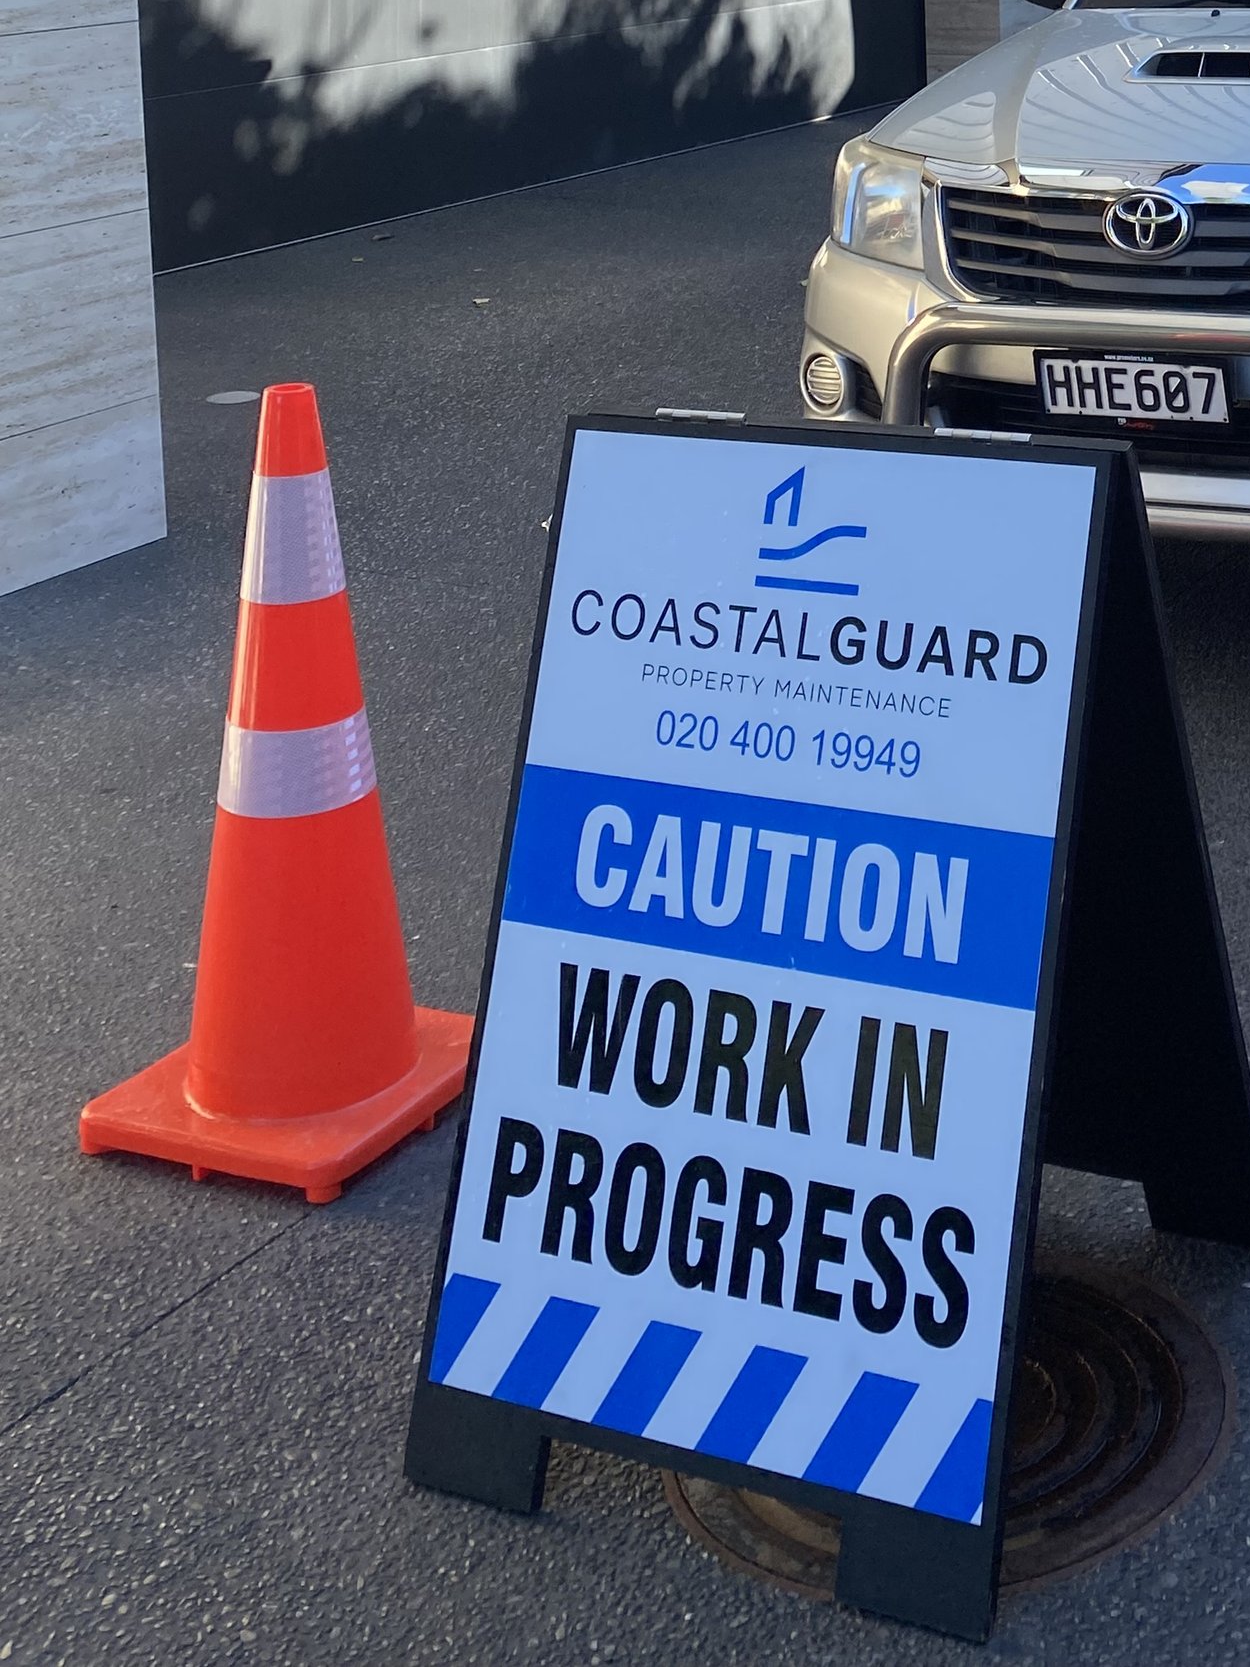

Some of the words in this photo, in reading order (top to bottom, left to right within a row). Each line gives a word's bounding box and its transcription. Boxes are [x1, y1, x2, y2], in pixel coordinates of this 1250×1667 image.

[1045, 364, 1217, 415] HHE607
[571, 589, 1048, 685] COASTALGUARD
[641, 663, 766, 696] PROPERTY
[773, 678, 953, 719] MAINTENANCE
[655, 709, 720, 752] 020
[729, 719, 796, 763] 400
[811, 728, 921, 779] 19949
[576, 804, 969, 964] CAUTION
[557, 961, 827, 1137] WORK
[845, 1015, 950, 1161] IN
[481, 1115, 976, 1350] PROGRESS
